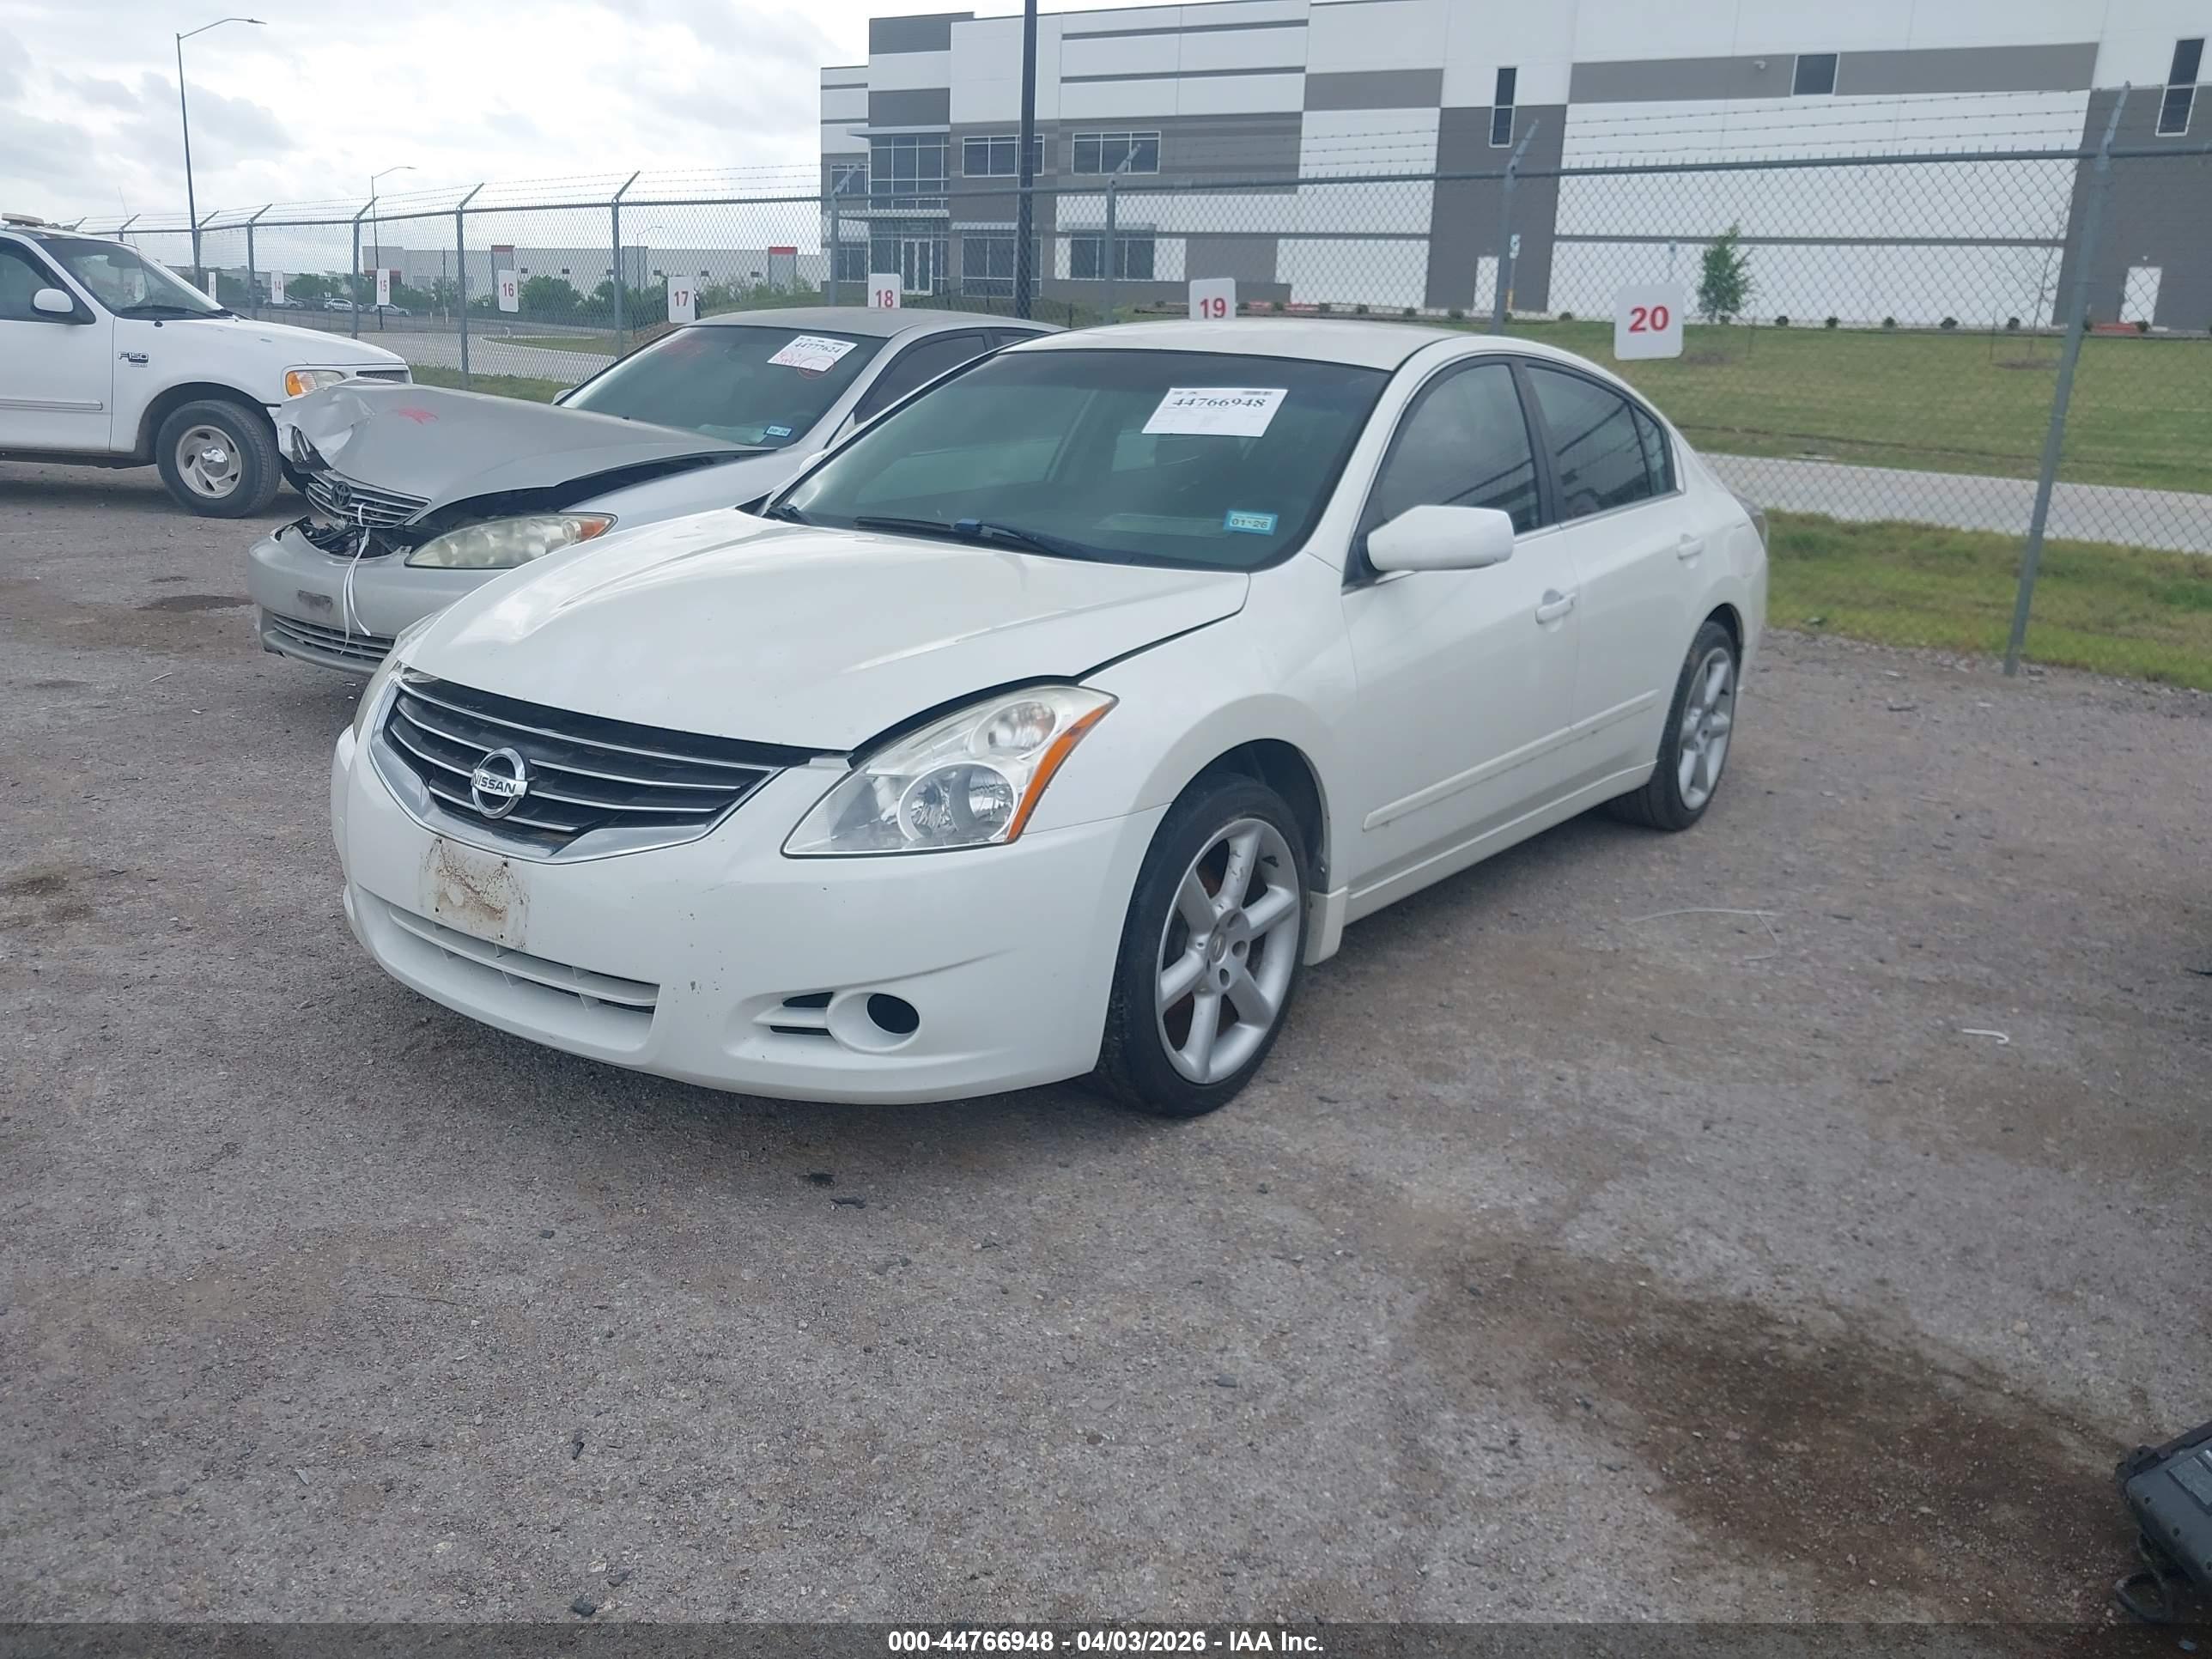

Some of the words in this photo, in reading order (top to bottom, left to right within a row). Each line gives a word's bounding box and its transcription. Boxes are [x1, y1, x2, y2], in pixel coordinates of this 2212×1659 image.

[274, 281, 282, 291] 14
[380, 280, 387, 292] 15
[502, 283, 514, 297] 16
[674, 291, 689, 307] 17
[875, 289, 894, 307] 18
[1200, 298, 1226, 319] 19
[1628, 306, 1669, 332] 20
[1172, 398, 1267, 408] 44766948
[473, 773, 517, 794] NISSAN
